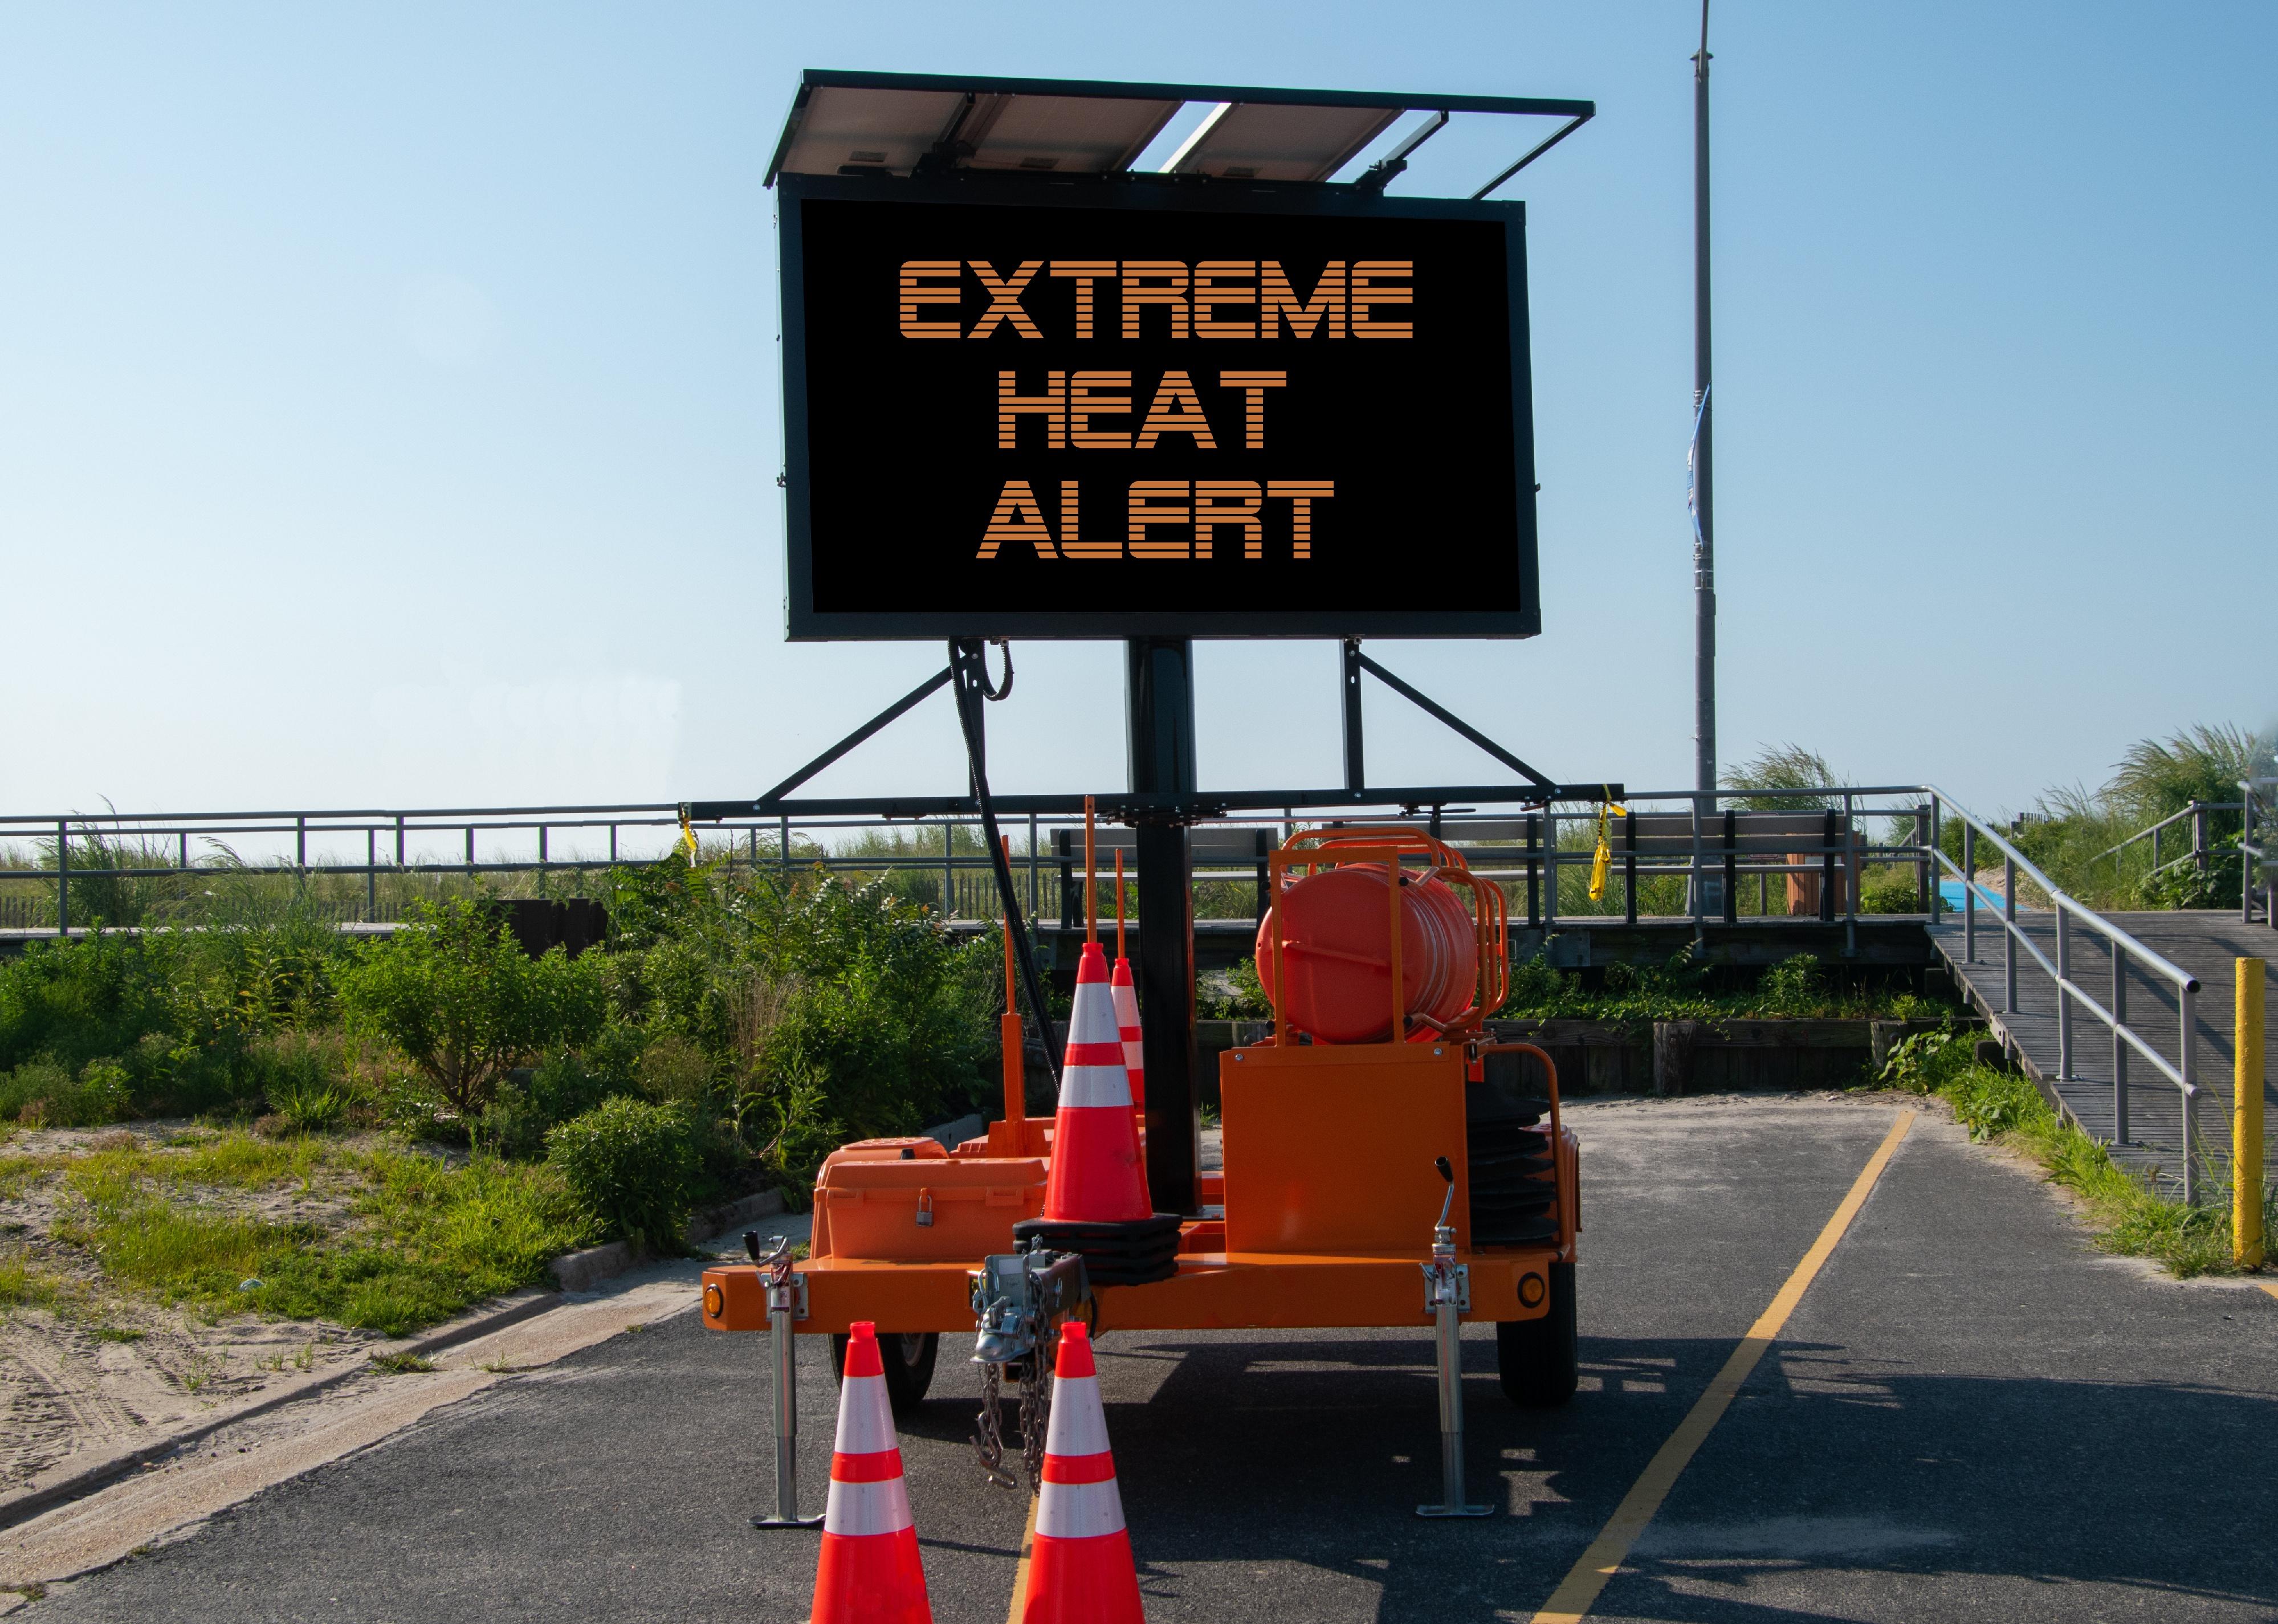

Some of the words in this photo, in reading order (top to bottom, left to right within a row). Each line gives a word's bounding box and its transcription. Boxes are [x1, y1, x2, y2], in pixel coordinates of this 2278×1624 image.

[900, 261, 1412, 338] EXTREME
[999, 371, 1286, 448] HEAT
[976, 481, 1334, 558] ALERT
